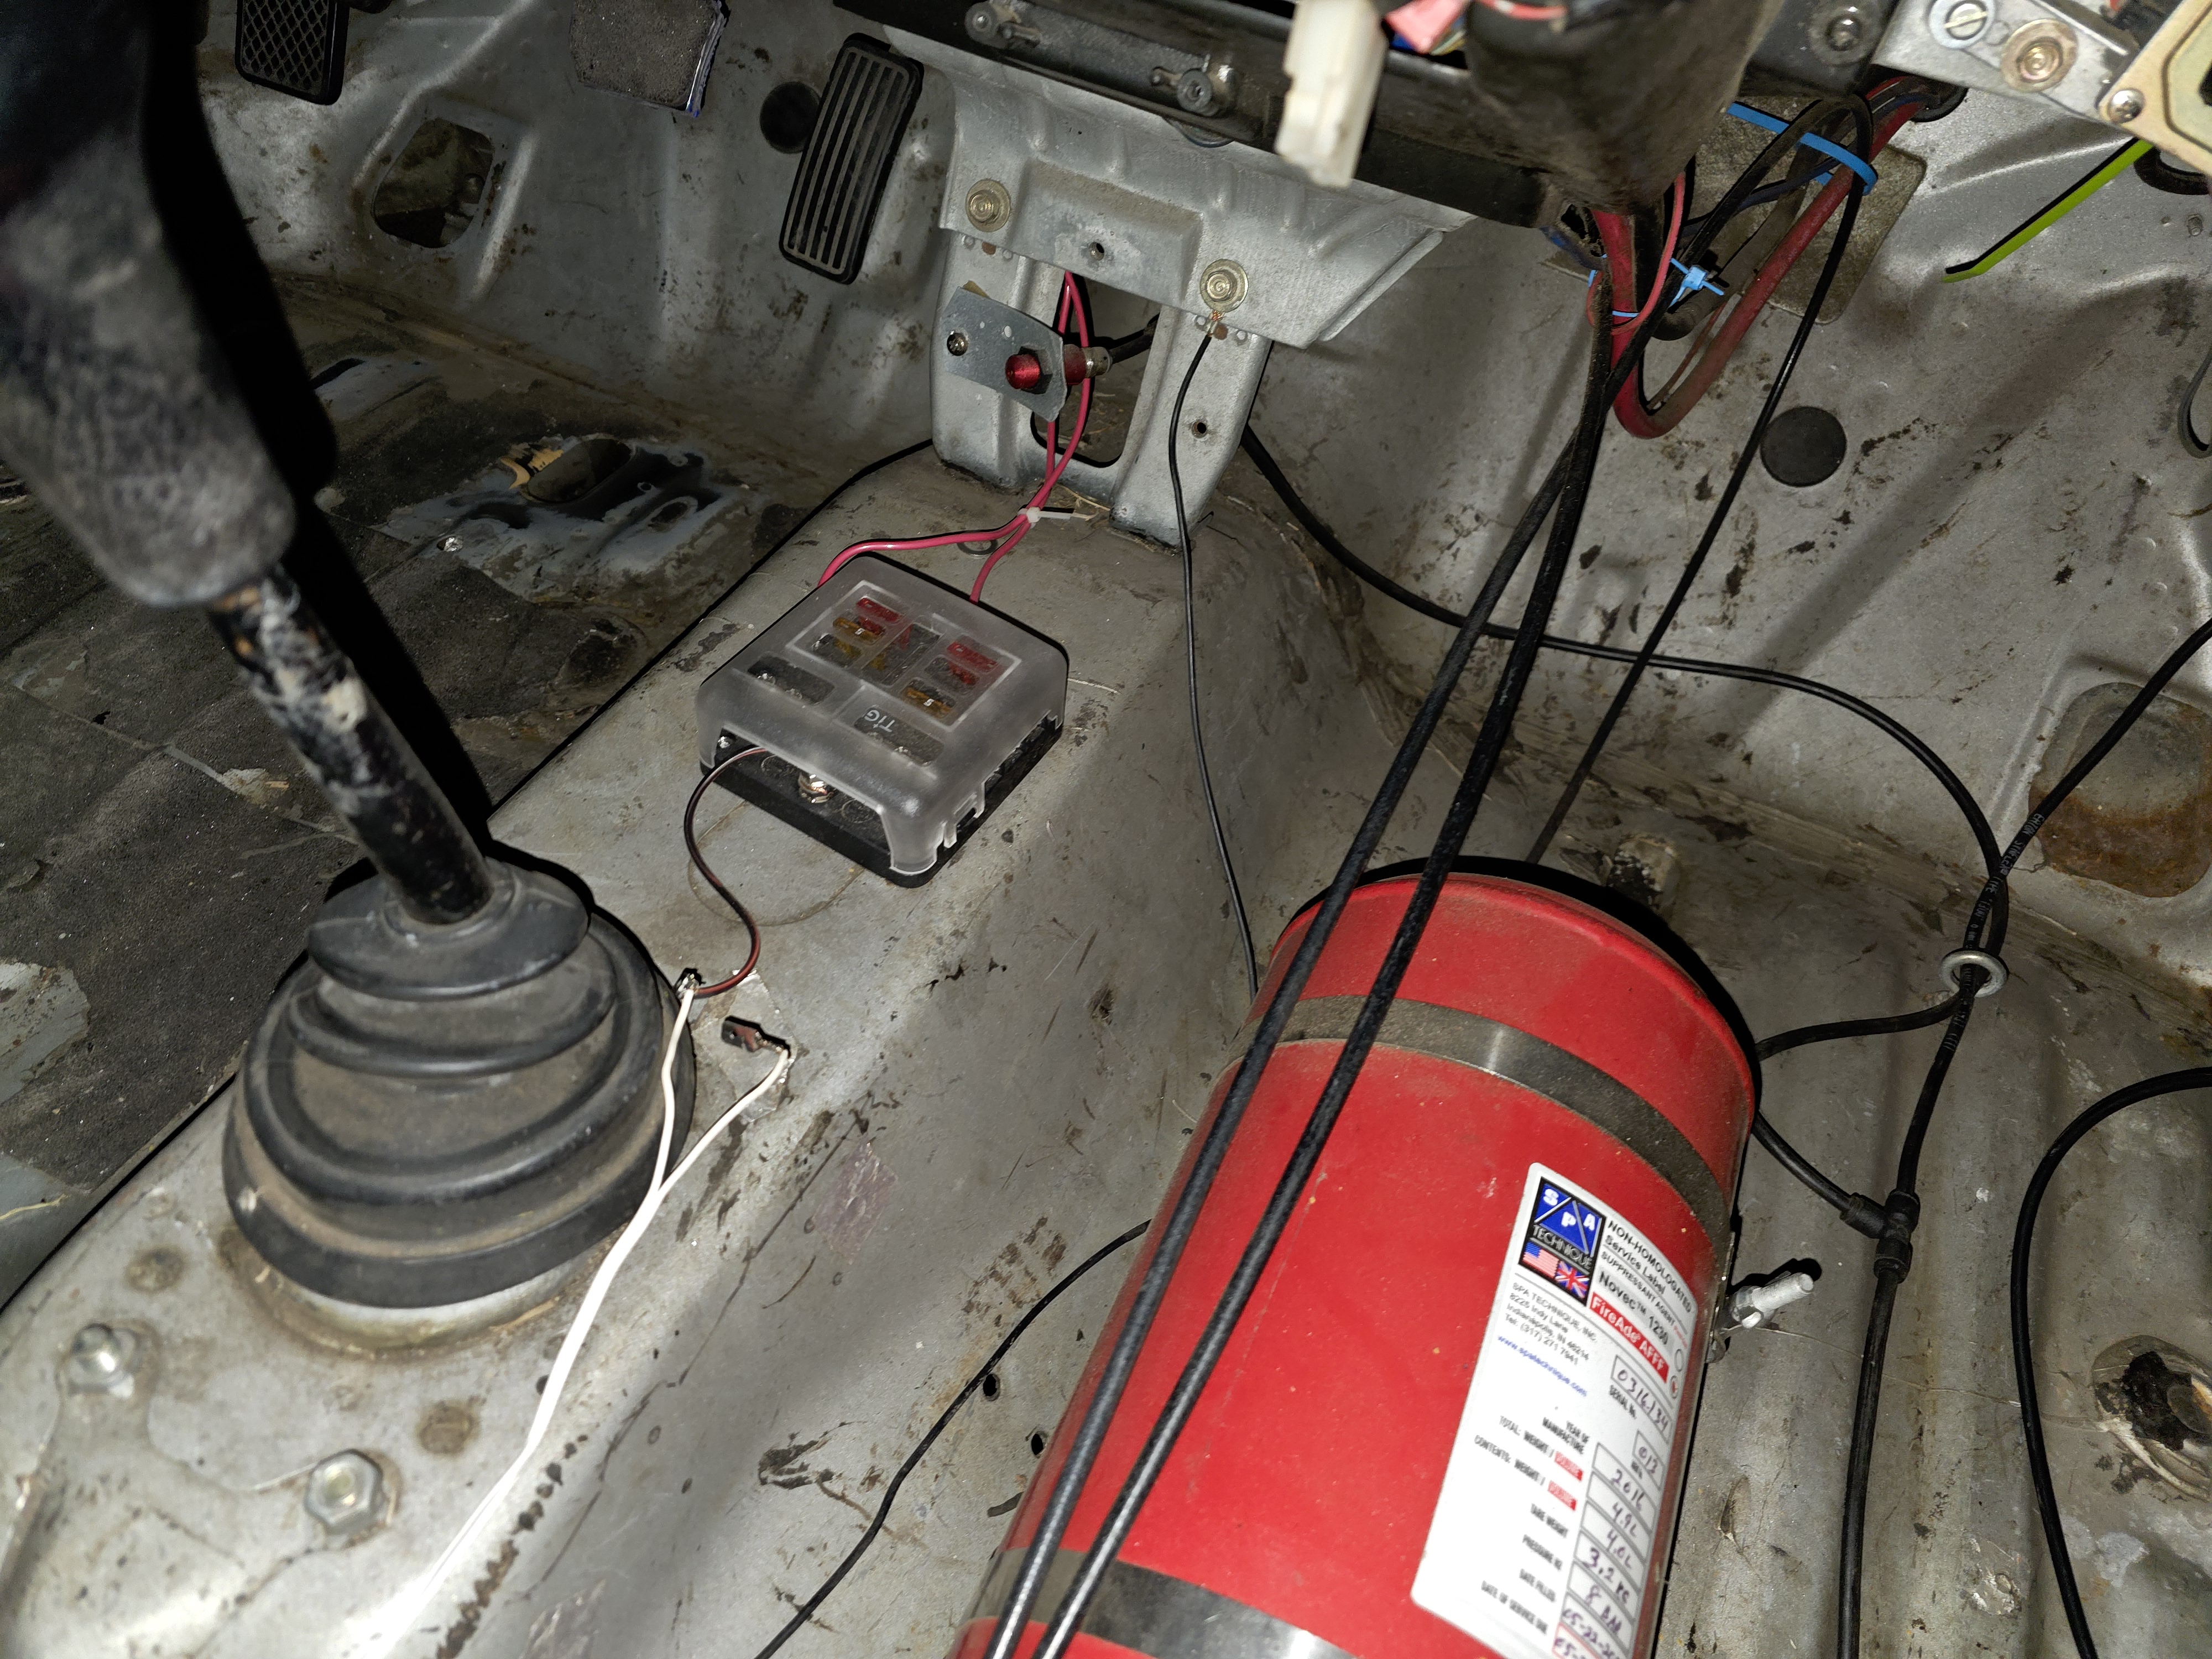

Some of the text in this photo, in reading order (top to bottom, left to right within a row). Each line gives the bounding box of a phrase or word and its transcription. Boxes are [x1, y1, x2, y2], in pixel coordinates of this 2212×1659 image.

[1533, 1225, 1592, 1269] TECHNIQUE
[1605, 1235, 1666, 1294] Service Label
[1608, 1220, 1692, 1313] NON-HOMOLOGATED
[1601, 1251, 1656, 1302] SUPPRESSANT
[1649, 1316, 1668, 1345] 1230
[1639, 1340, 1665, 1370] AFFF
